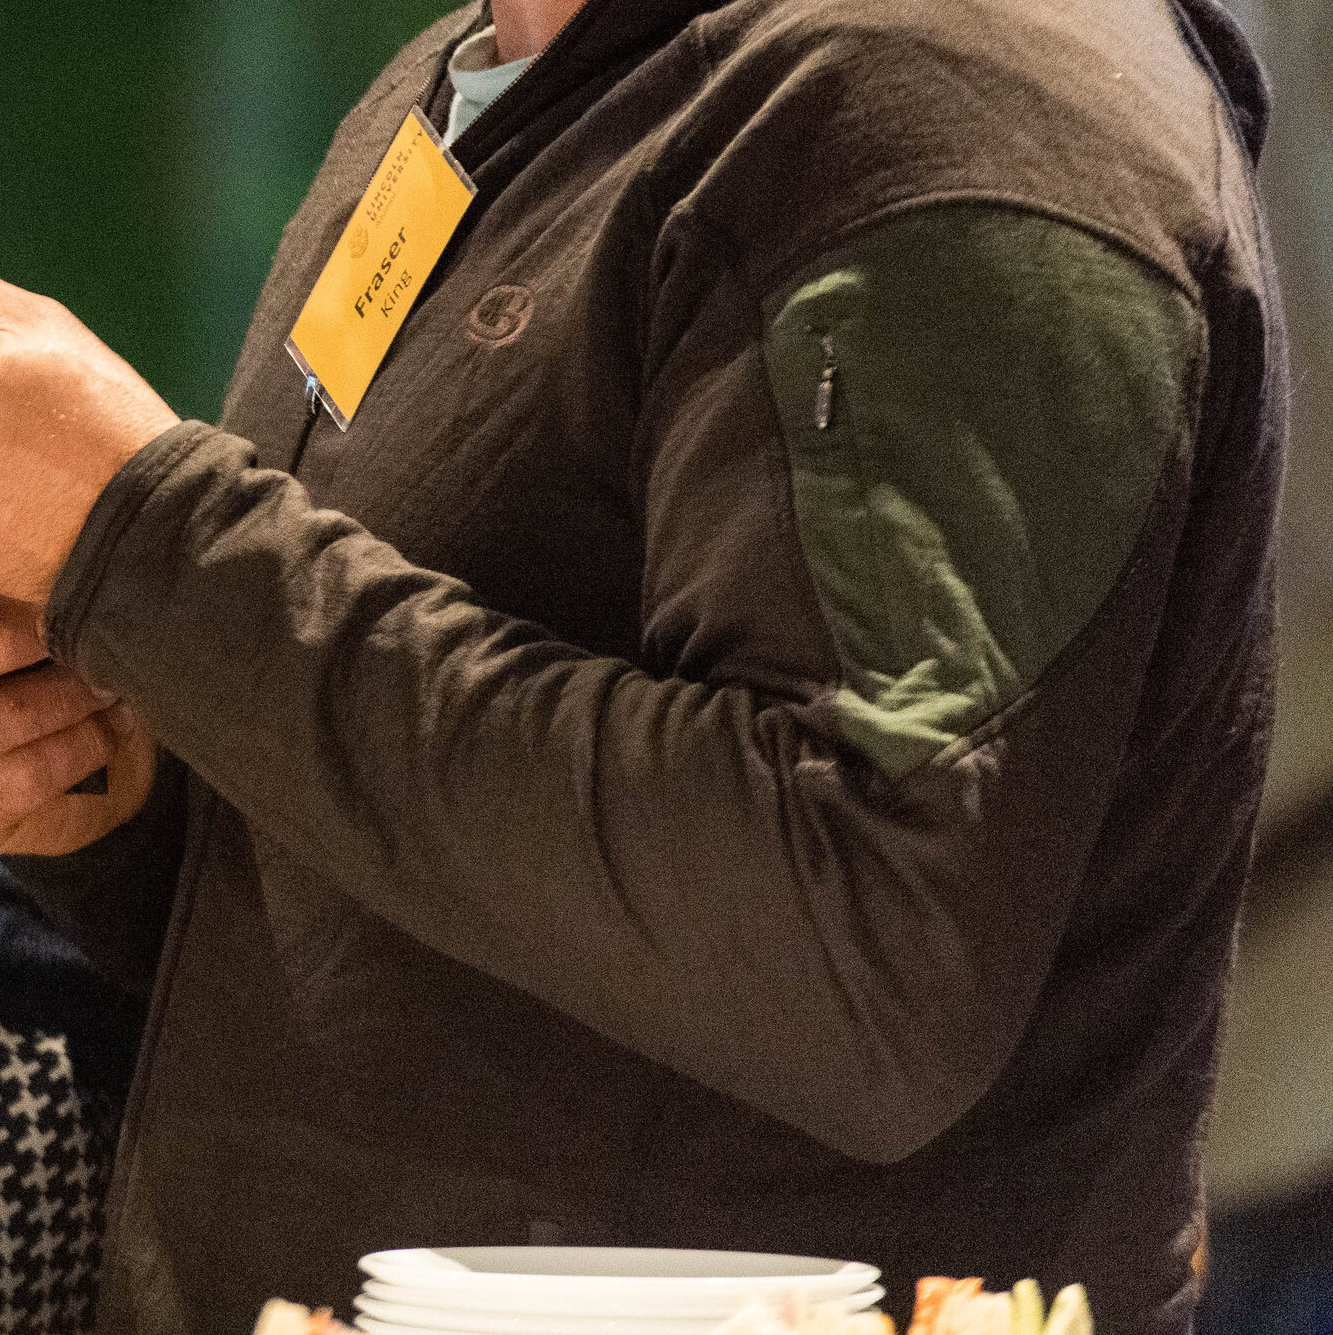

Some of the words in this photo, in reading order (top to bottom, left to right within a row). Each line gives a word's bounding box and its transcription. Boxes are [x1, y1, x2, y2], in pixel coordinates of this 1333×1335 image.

[366, 151, 404, 216] LINCOLN
[369, 129, 424, 222] UNIVERSITY
[354, 226, 408, 320] Fraser
[380, 268, 413, 318] King
